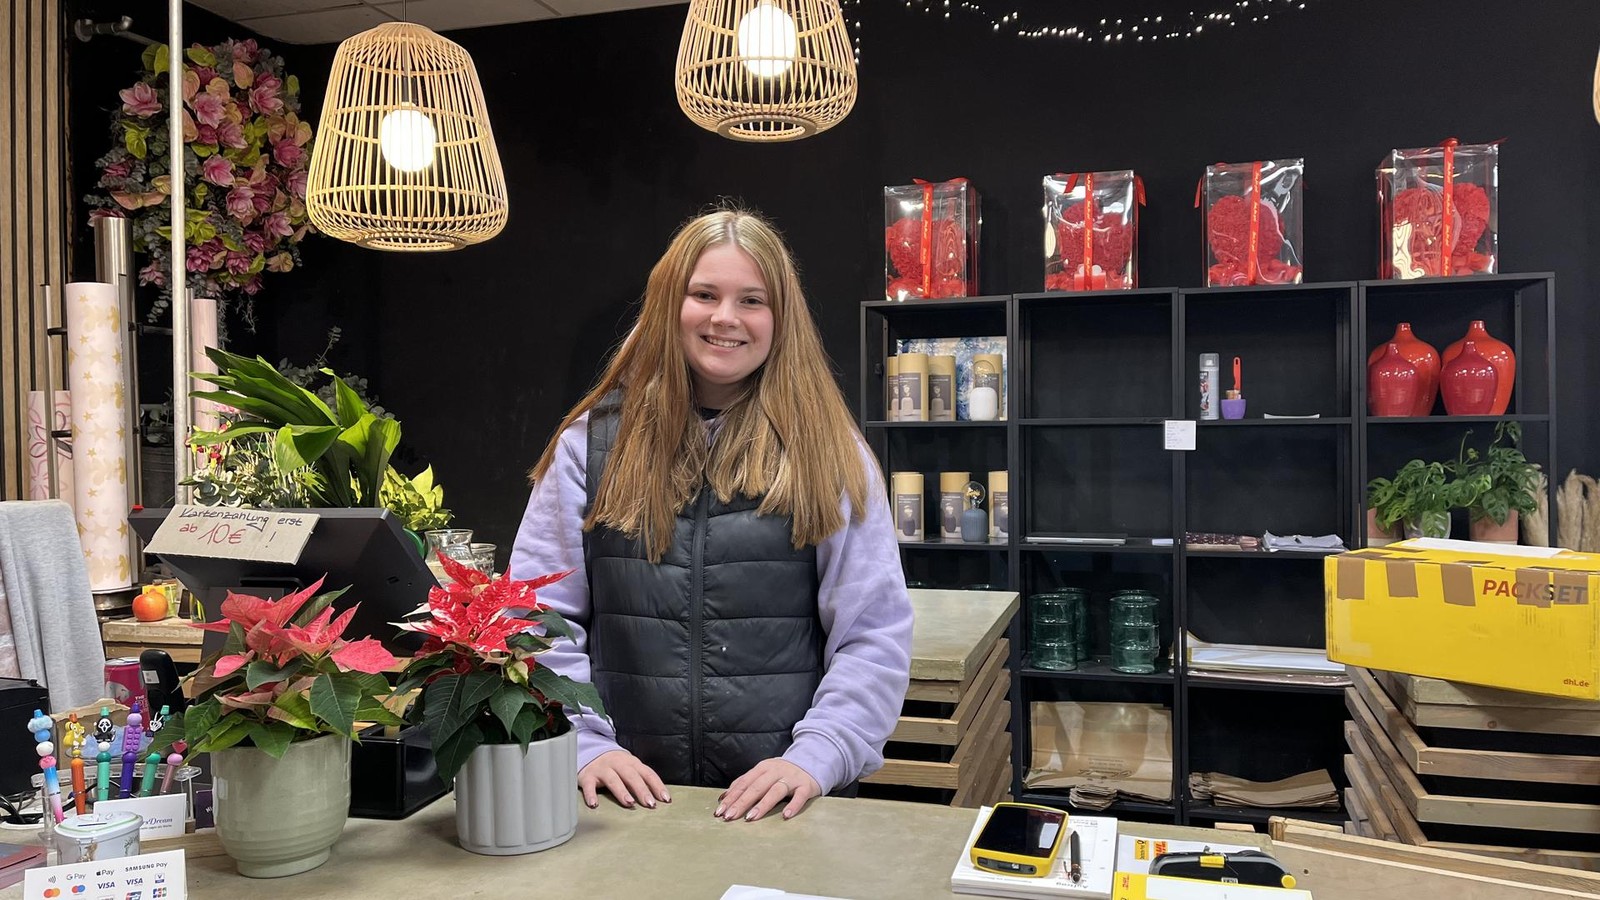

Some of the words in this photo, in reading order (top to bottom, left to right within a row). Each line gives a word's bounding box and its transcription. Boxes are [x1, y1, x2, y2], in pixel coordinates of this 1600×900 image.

[179, 507, 269, 532] Kartenzahlung
[277, 517, 303, 526] erst
[179, 523, 198, 533] ab
[198, 522, 246, 545] 10€
[1482, 579, 1588, 604] PACKSET
[1563, 678, 1590, 688] dhl.de
[102, 868, 115, 876] Pay
[125, 864, 155, 872] SAMSUNG
[98, 881, 116, 889] VISA
[126, 877, 143, 885] VISA
